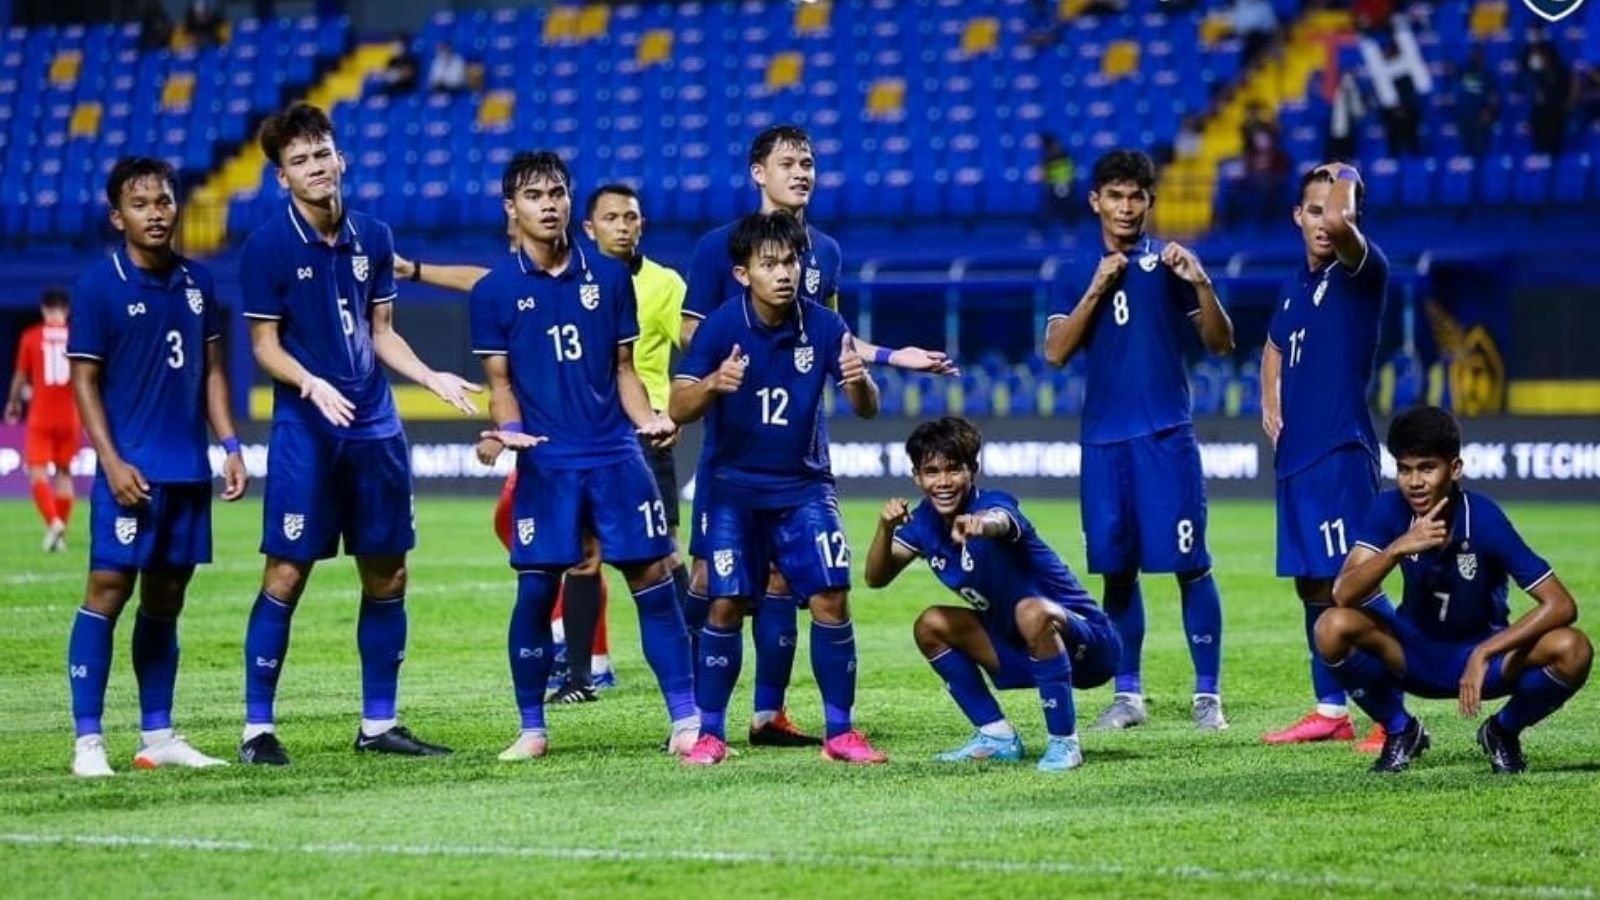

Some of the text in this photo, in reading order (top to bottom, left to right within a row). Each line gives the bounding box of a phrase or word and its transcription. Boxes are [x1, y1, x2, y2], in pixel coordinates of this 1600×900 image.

[337, 298, 354, 336] 5
[1113, 290, 1129, 325] 8
[166, 330, 184, 368] 3
[546, 323, 583, 362] 13
[756, 387, 789, 425] 12
[637, 499, 668, 538] 13
[1177, 519, 1193, 553] 8
[1319, 517, 1348, 558] 11
[815, 531, 849, 568] 12
[1433, 591, 1450, 622] 7
